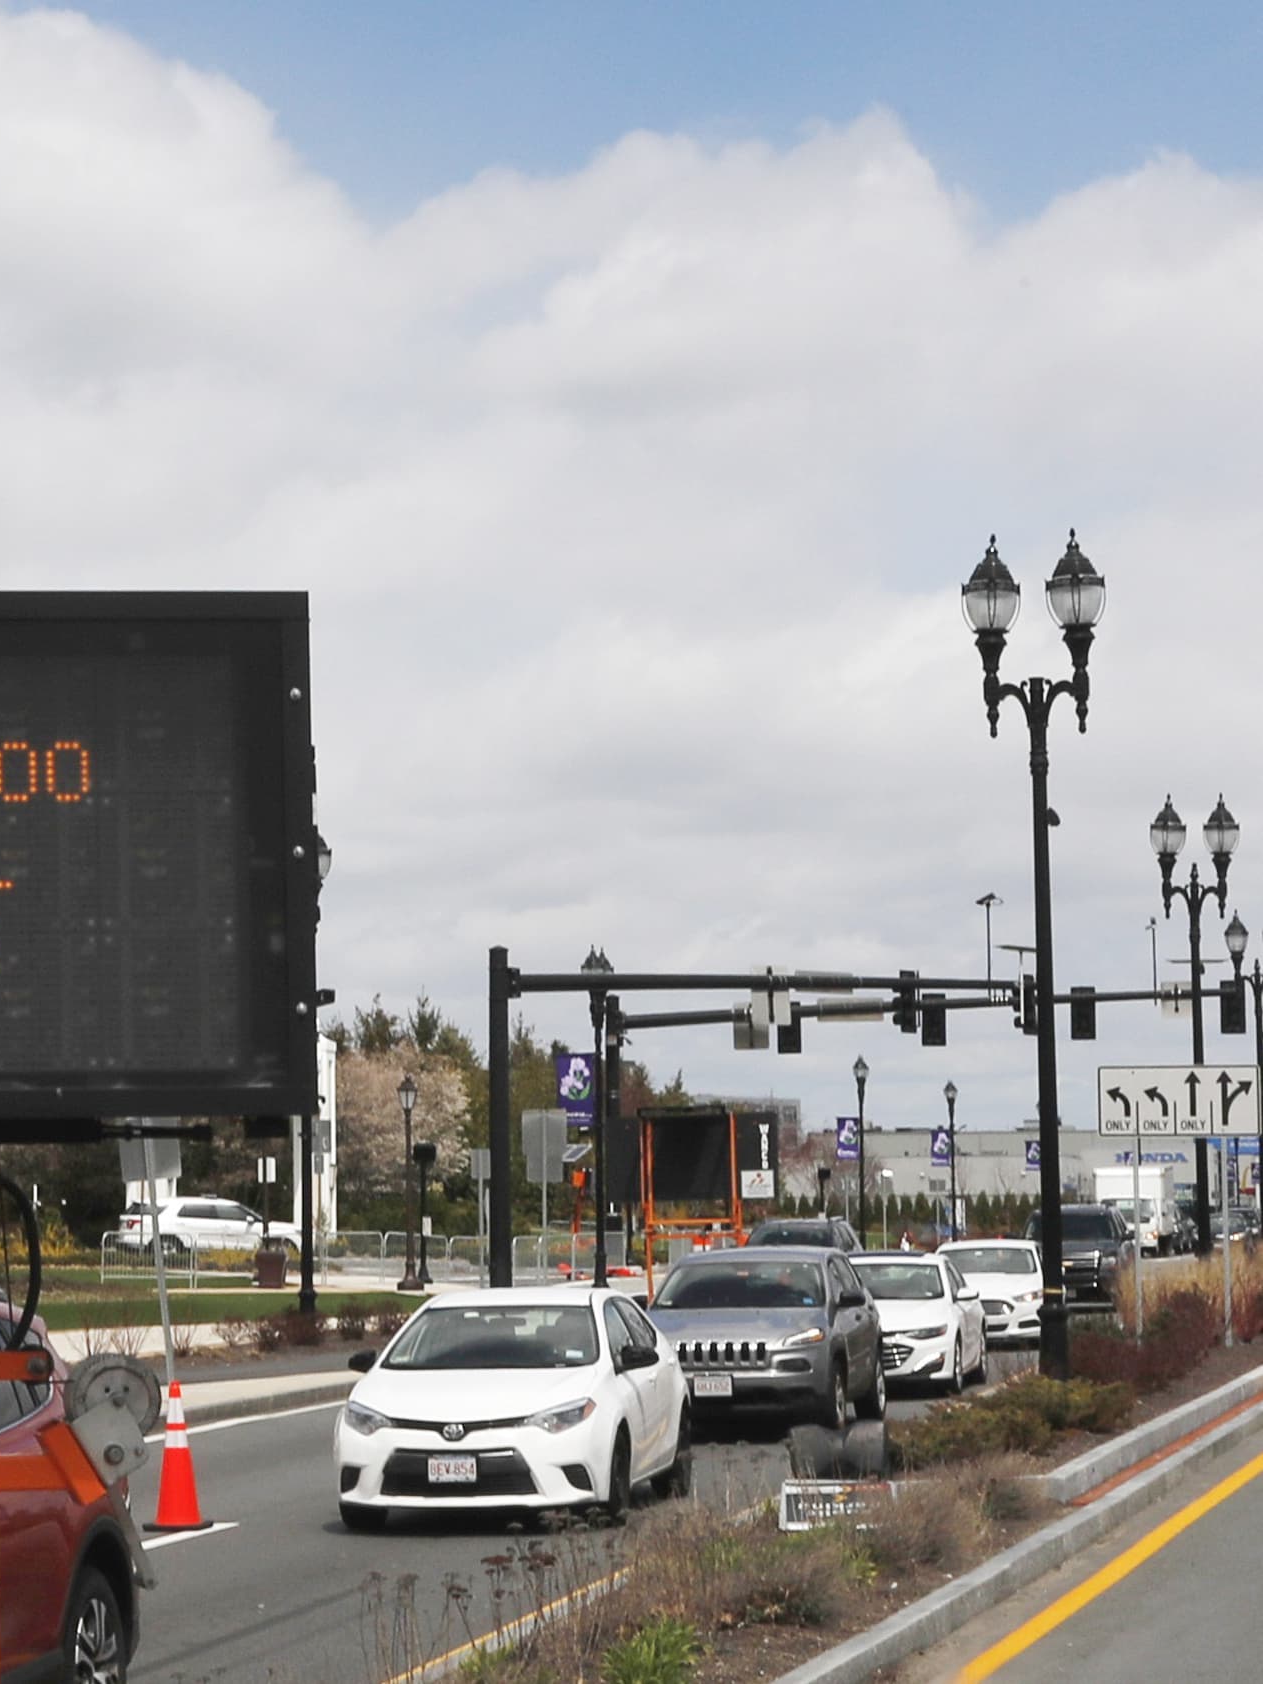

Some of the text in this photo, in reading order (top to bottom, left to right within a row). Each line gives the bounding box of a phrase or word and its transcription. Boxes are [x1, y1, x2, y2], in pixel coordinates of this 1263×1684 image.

[1105, 1120, 1131, 1131] ONLY
[1143, 1119, 1169, 1131] ONLY
[1180, 1119, 1206, 1131] ONLY
[1115, 1151, 1189, 1163] HNDA
